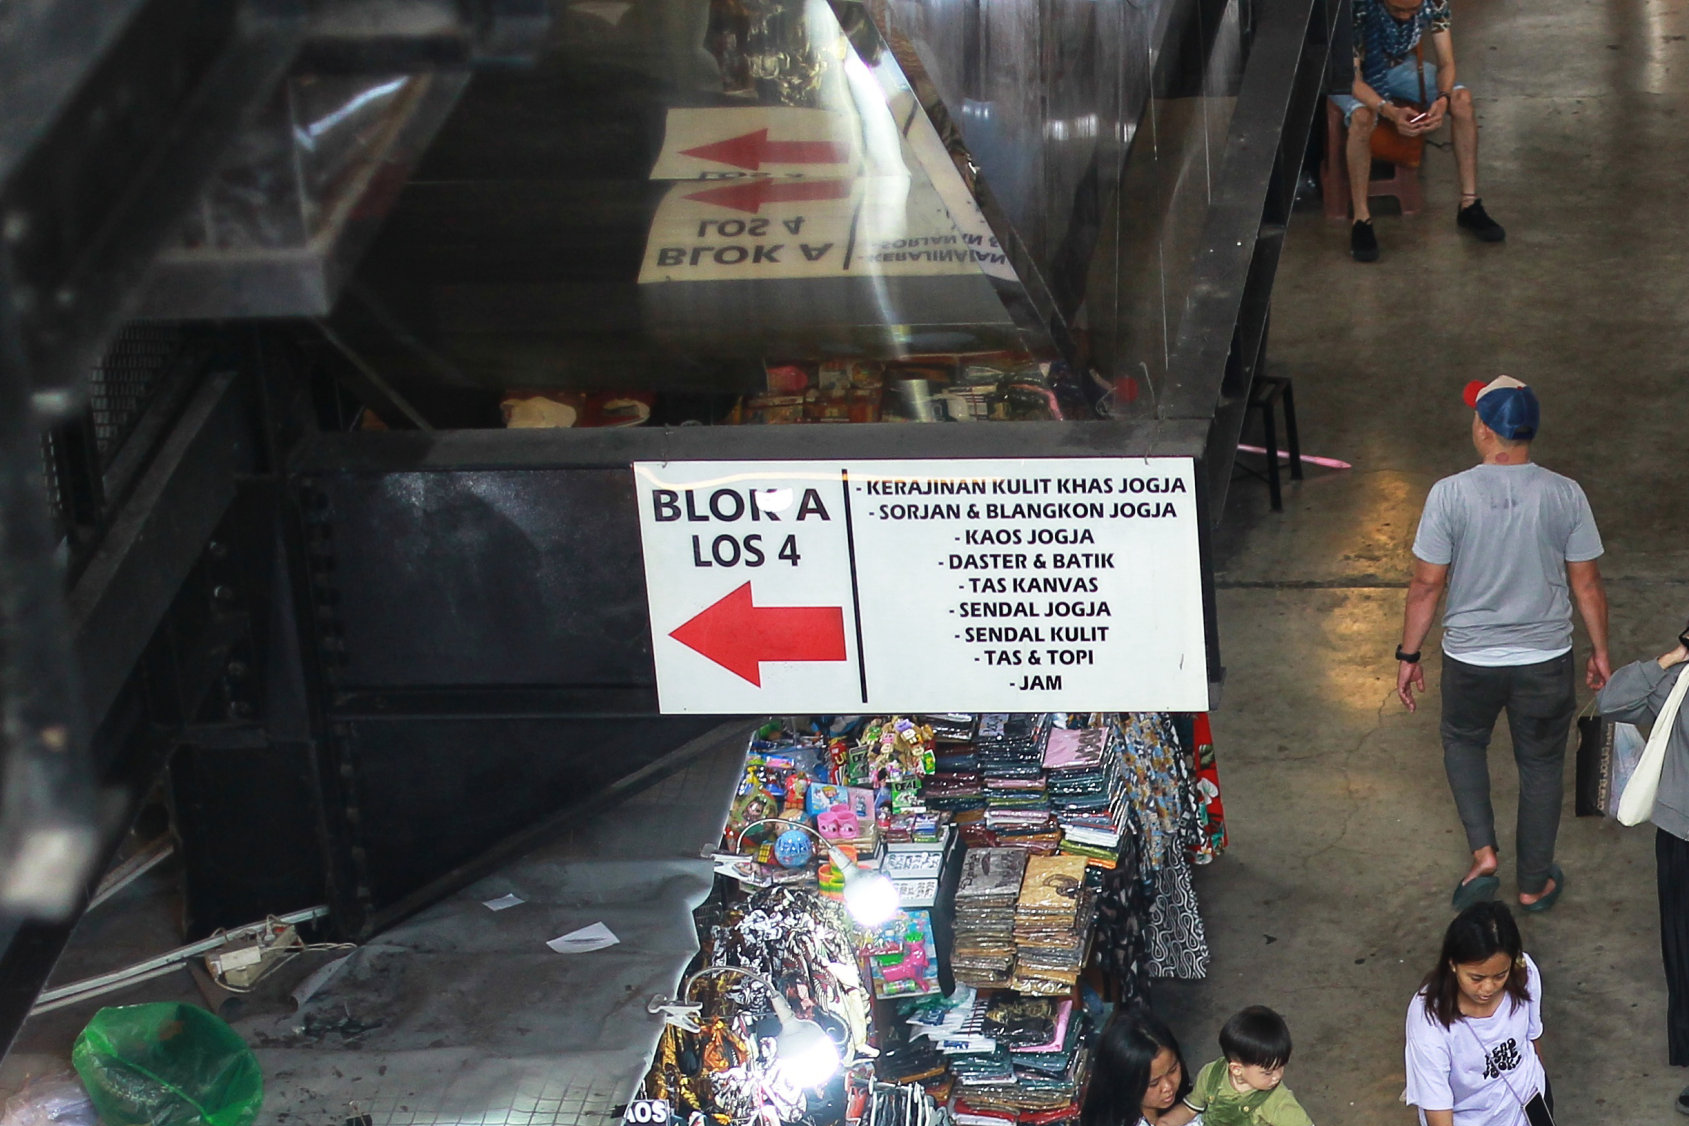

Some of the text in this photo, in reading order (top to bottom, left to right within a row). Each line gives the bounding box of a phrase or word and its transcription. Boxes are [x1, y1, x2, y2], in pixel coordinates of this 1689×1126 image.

[867, 479, 986, 496] KERAJINAN
[992, 478, 1052, 495] KULIT
[1057, 477, 1114, 494] KHAS
[1118, 477, 1187, 494] JOGJA
[796, 488, 831, 522] A
[879, 503, 961, 520] SORJAN
[966, 503, 980, 520] &
[986, 502, 1104, 520] BLANGKON
[1109, 502, 1177, 519] JOGJA
[965, 529, 1022, 546] KAOS
[1027, 528, 1095, 545] JOGJA
[692, 533, 801, 568] LOS 4
[949, 553, 1027, 570] DASTER
[1033, 553, 1047, 570] &
[1052, 553, 1115, 570] BATIK
[968, 577, 1007, 594] TAS
[1012, 577, 1099, 594] KANVAS
[959, 601, 1040, 618] SENDAL
[1044, 601, 1112, 618] JOGJA
[965, 626, 1046, 643] SENDAL
[1050, 626, 1110, 643] KULIT
[983, 649, 1022, 666] TAS
[1027, 649, 1041, 666] &
[1046, 649, 1094, 666] TOPI
[1019, 675, 1062, 691] JAM
[626, 1101, 668, 1124] AOS
